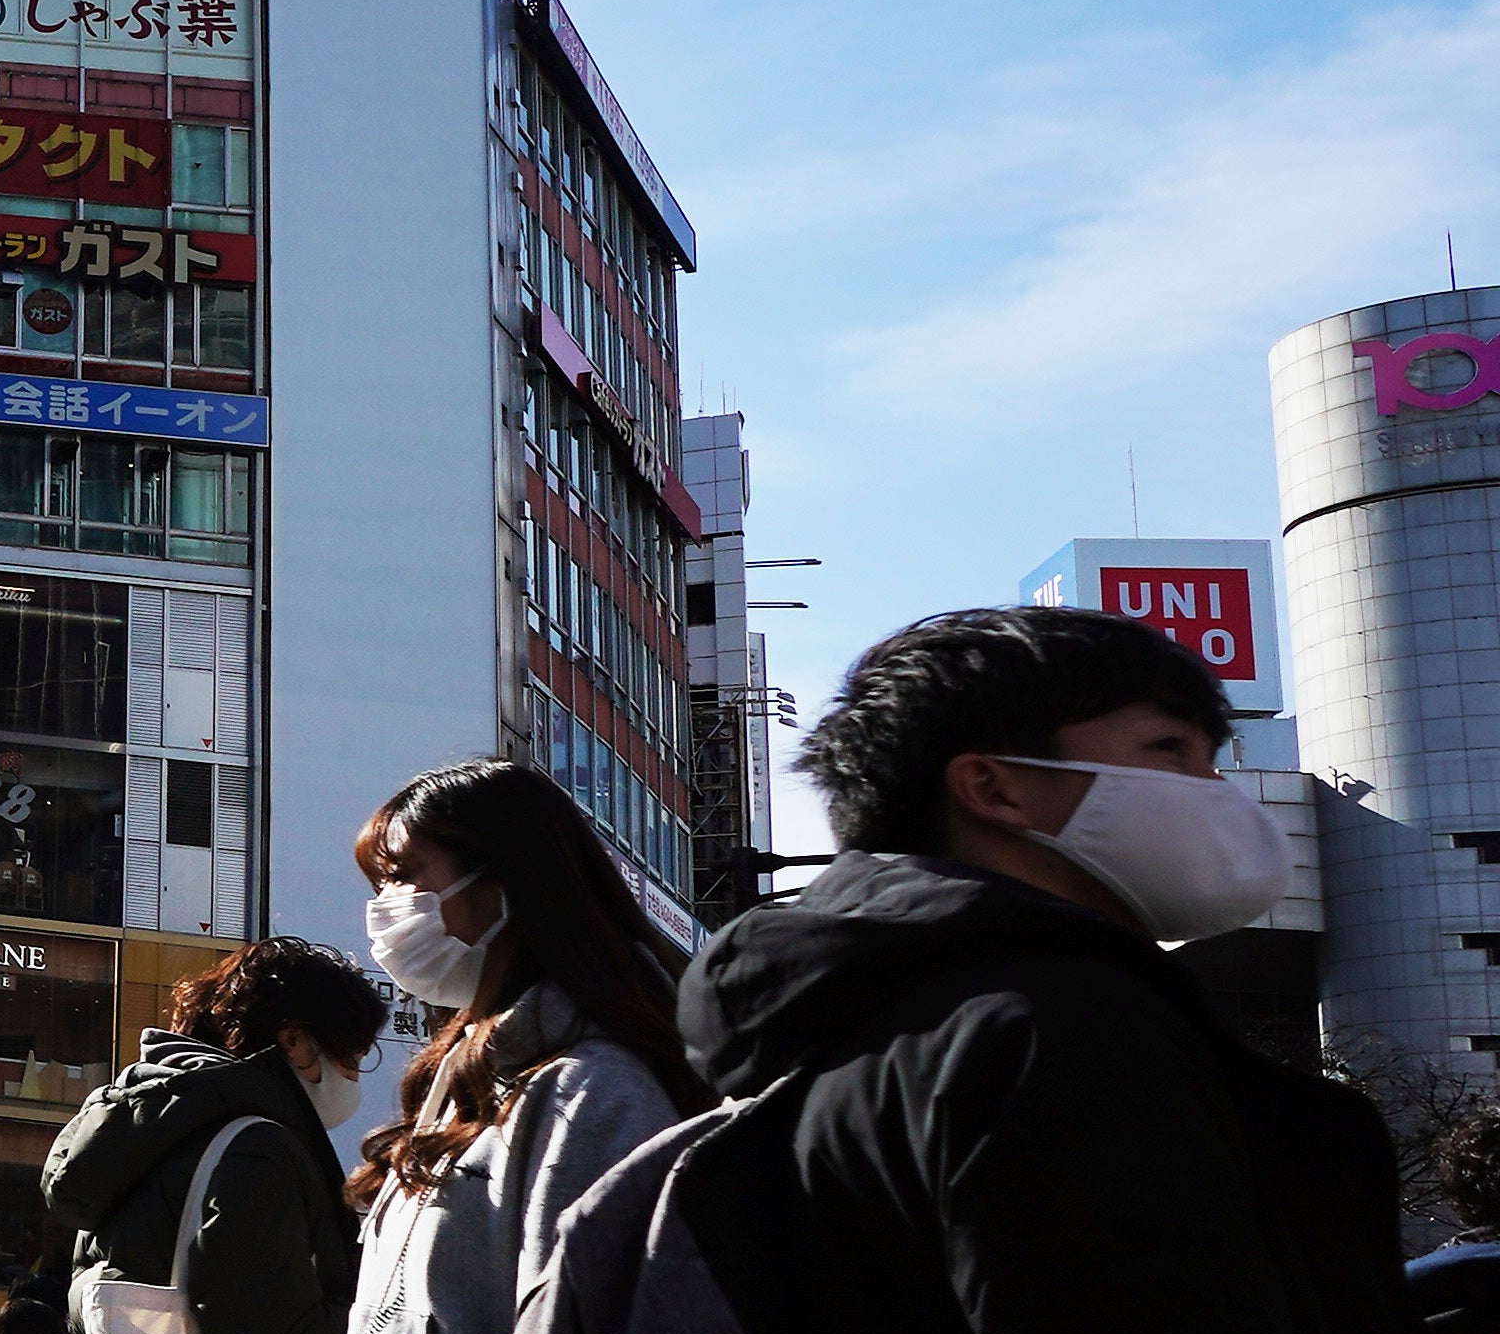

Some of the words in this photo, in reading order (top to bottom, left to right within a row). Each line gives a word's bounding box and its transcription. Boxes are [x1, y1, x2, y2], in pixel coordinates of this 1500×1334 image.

[59, 223, 218, 284] ガスト
[1352, 332, 1500, 416] 10
[1117, 581, 1223, 620] UNI
